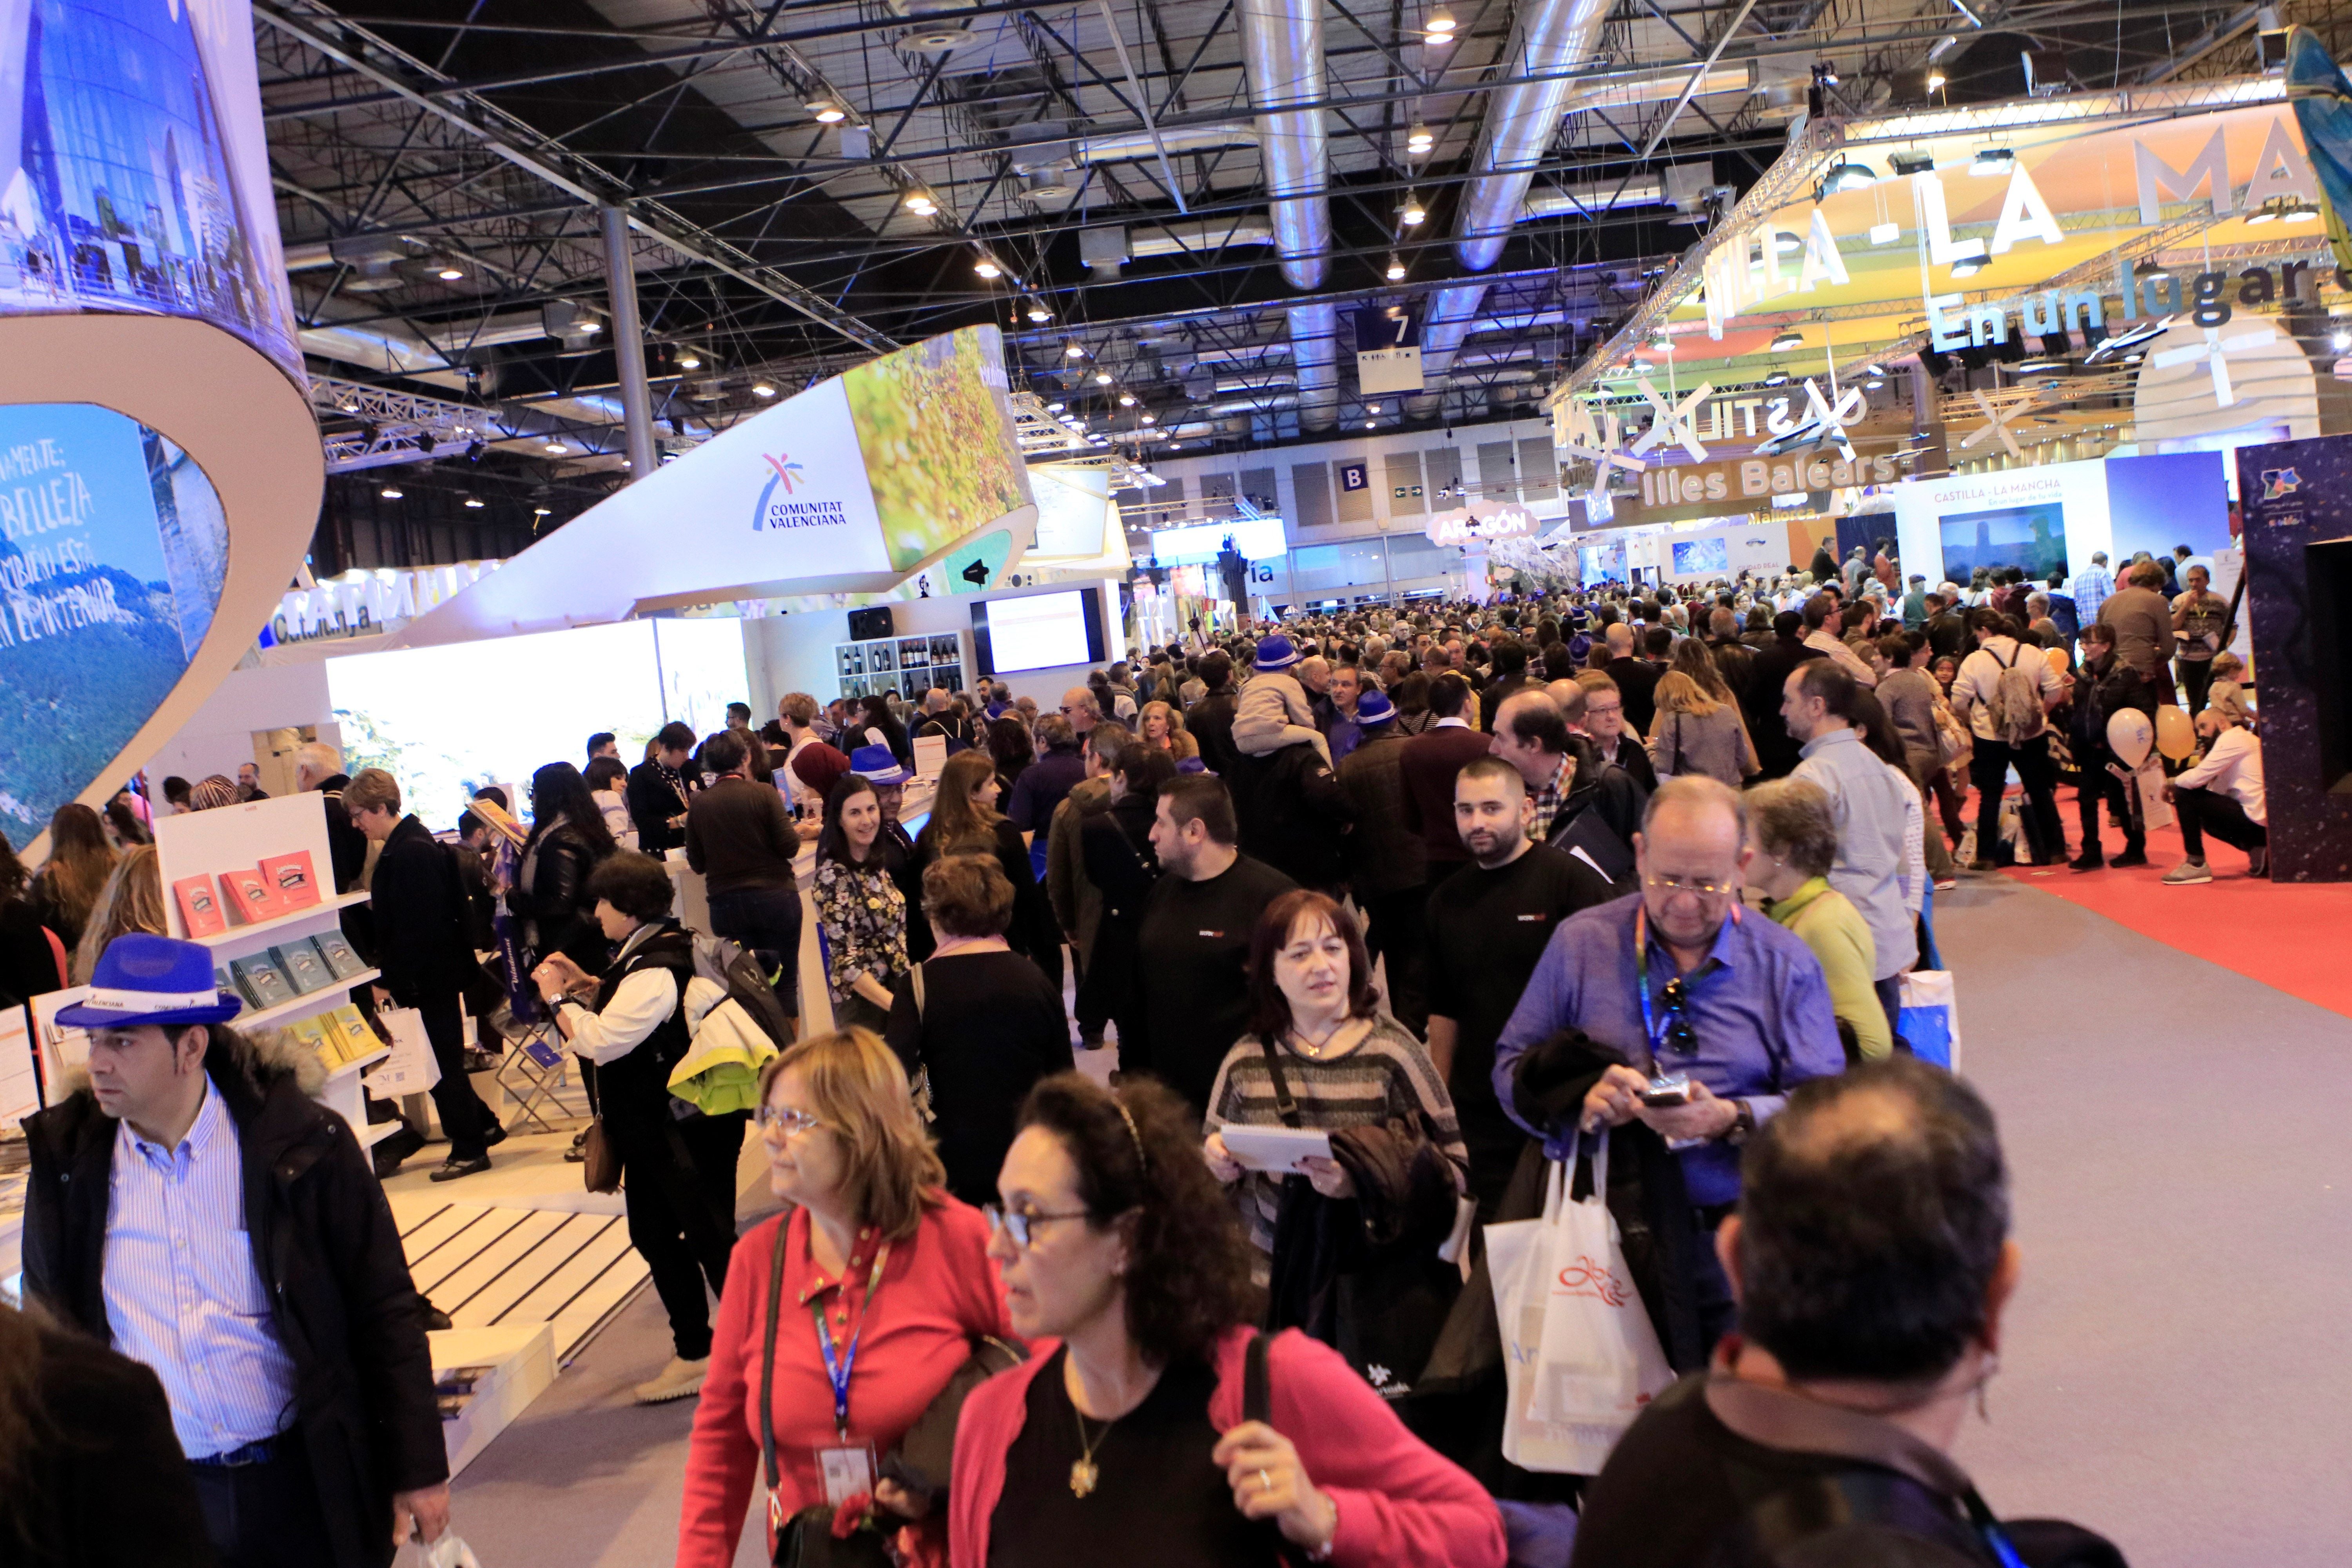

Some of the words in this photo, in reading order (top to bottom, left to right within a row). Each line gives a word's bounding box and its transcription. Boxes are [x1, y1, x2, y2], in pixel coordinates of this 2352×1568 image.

[1917, 161, 2065, 265] LA
[1930, 292, 2009, 353] En
[2022, 291, 2103, 337] un
[2120, 259, 2309, 328] lugar
[1392, 315, 1409, 342] 7
[1347, 469, 1361, 487] B
[1643, 468, 1728, 507] Illes
[1741, 453, 1896, 496] Balears
[1934, 489, 1985, 503] CASTILLA
[1994, 486, 2008, 496] LA
[2011, 479, 2061, 494] MANCHA
[0, 472, 95, 541] BELLEZA
[771, 501, 842, 516] COMUNITAT
[769, 514, 846, 529] VALENCIANA
